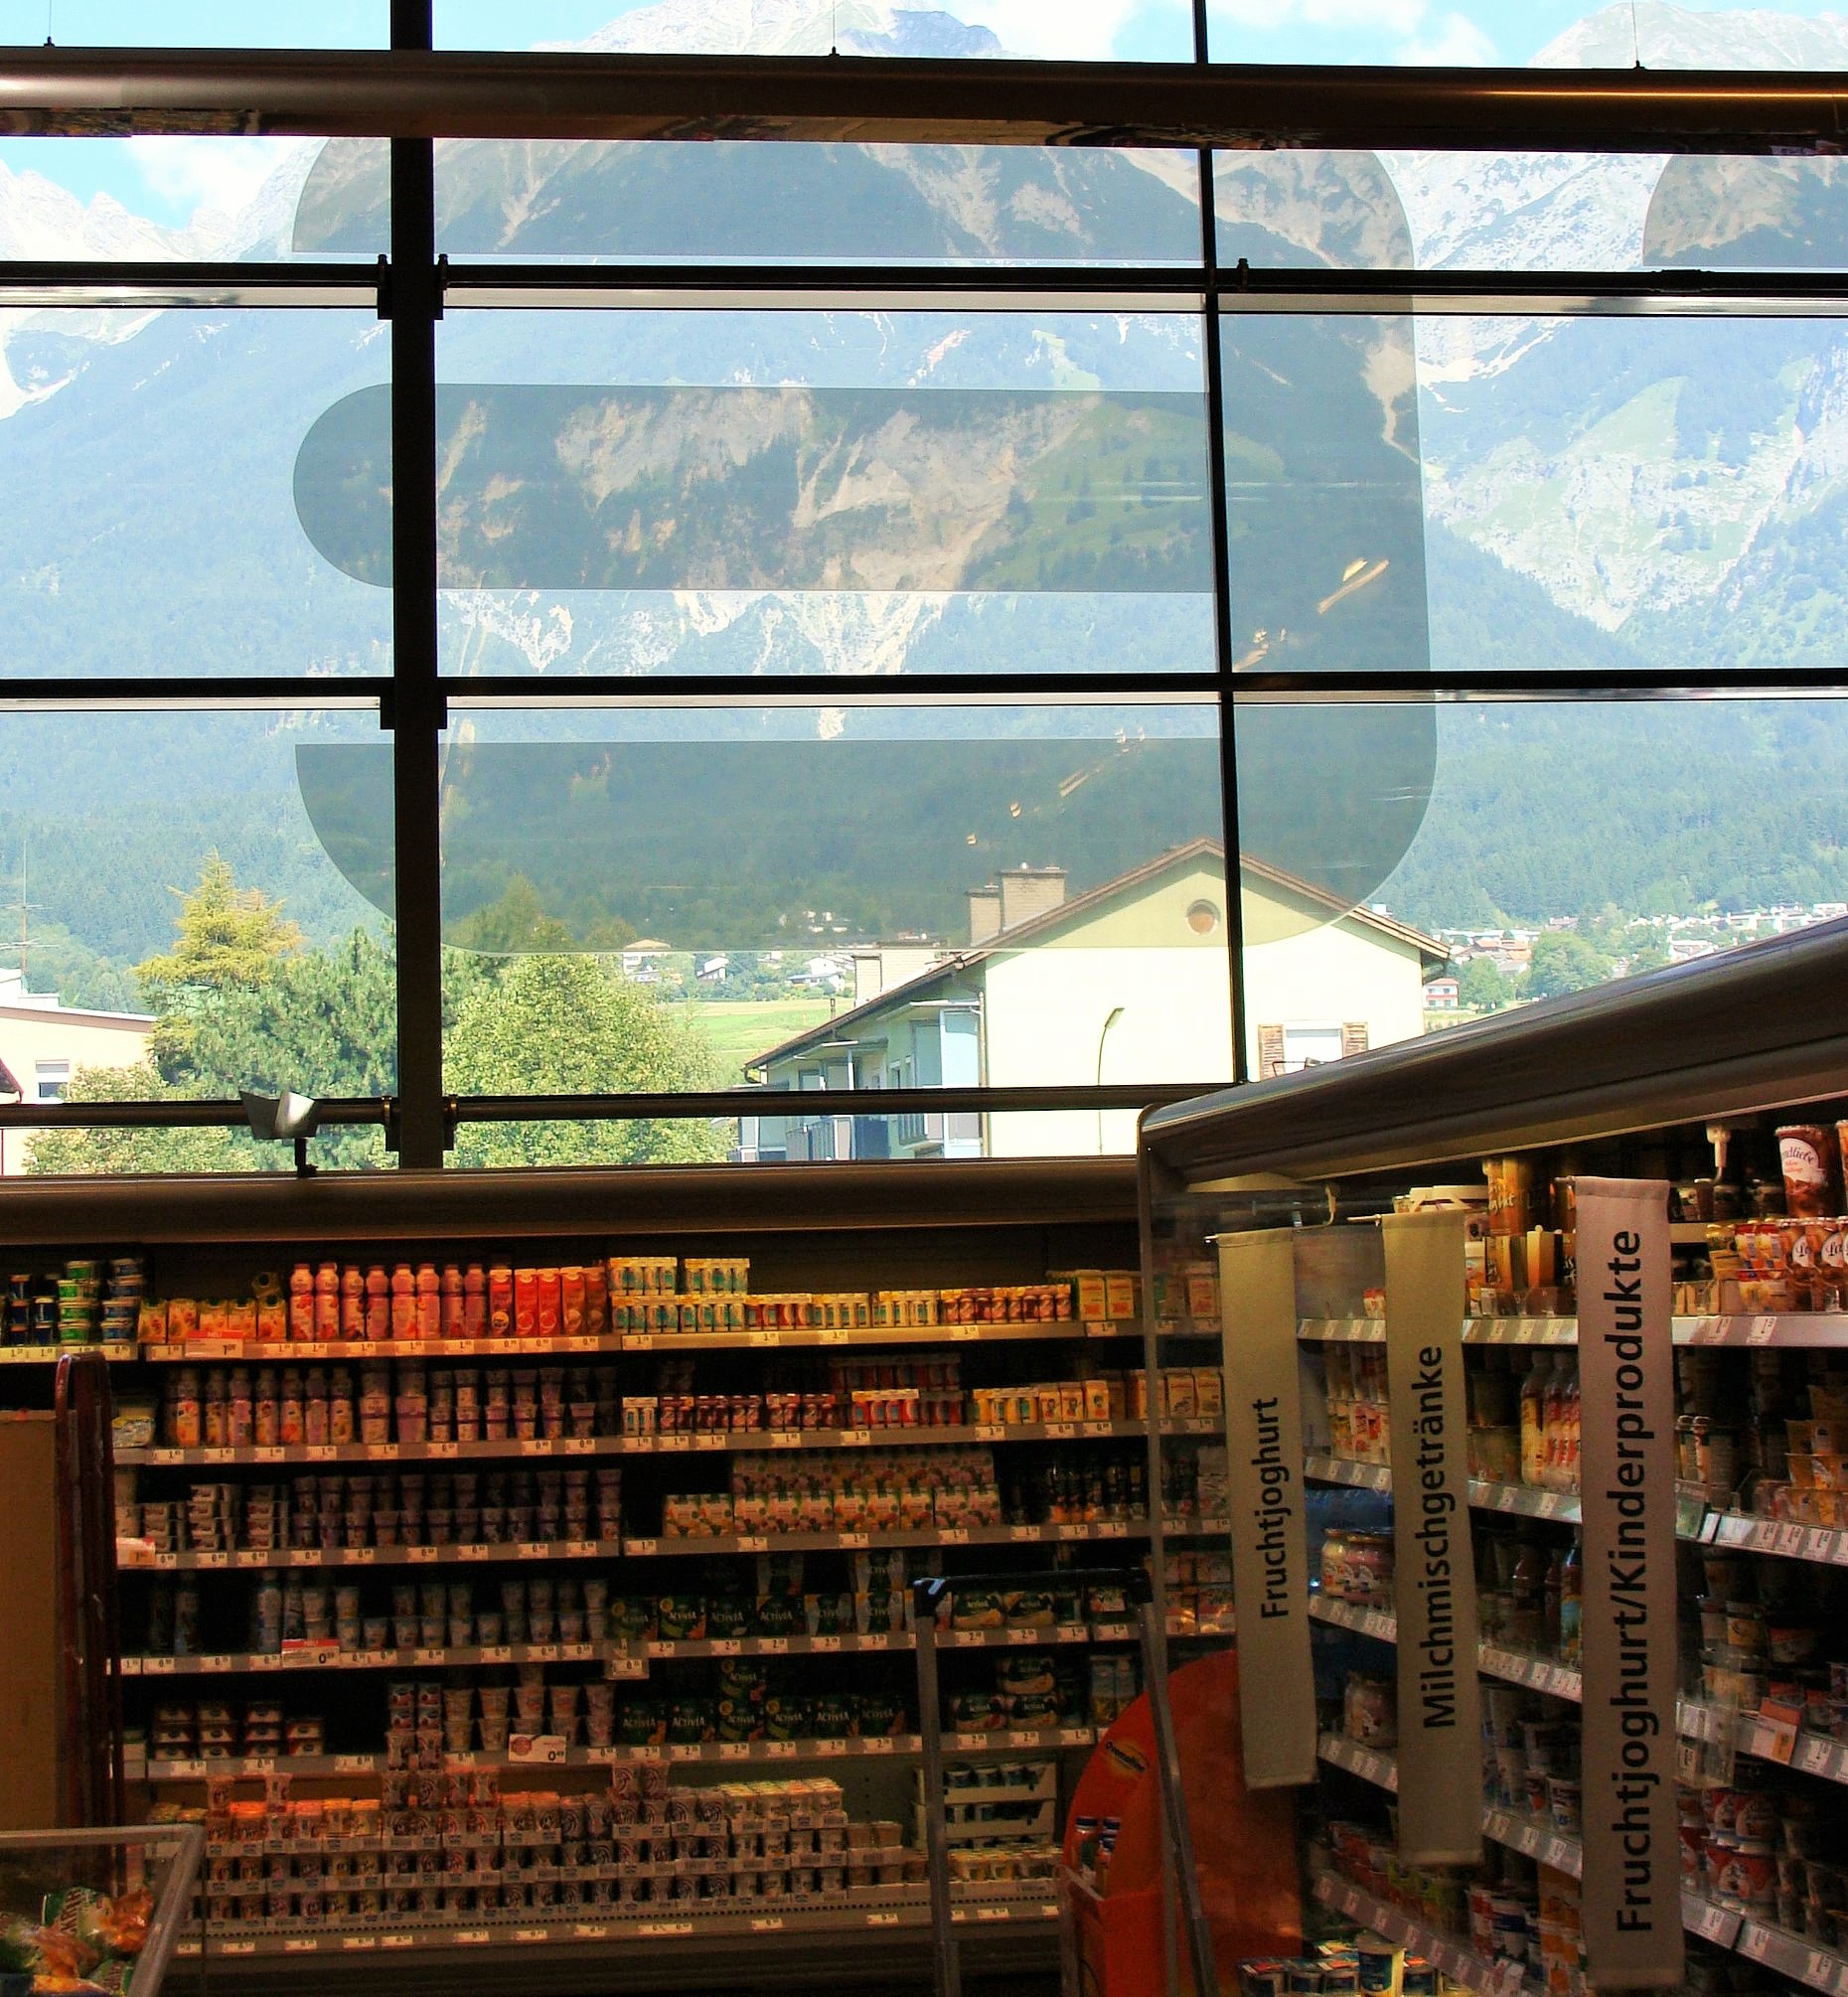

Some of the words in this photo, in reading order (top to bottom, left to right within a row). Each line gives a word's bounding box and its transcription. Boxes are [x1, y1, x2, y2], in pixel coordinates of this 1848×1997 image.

[1251, 1397, 1293, 1619] Fruchtjoghurt
[1411, 1346, 1457, 1729] Milchmischgetränke
[1604, 1230, 1661, 1933] Fruchtjoghurt/Kinderprodukte
